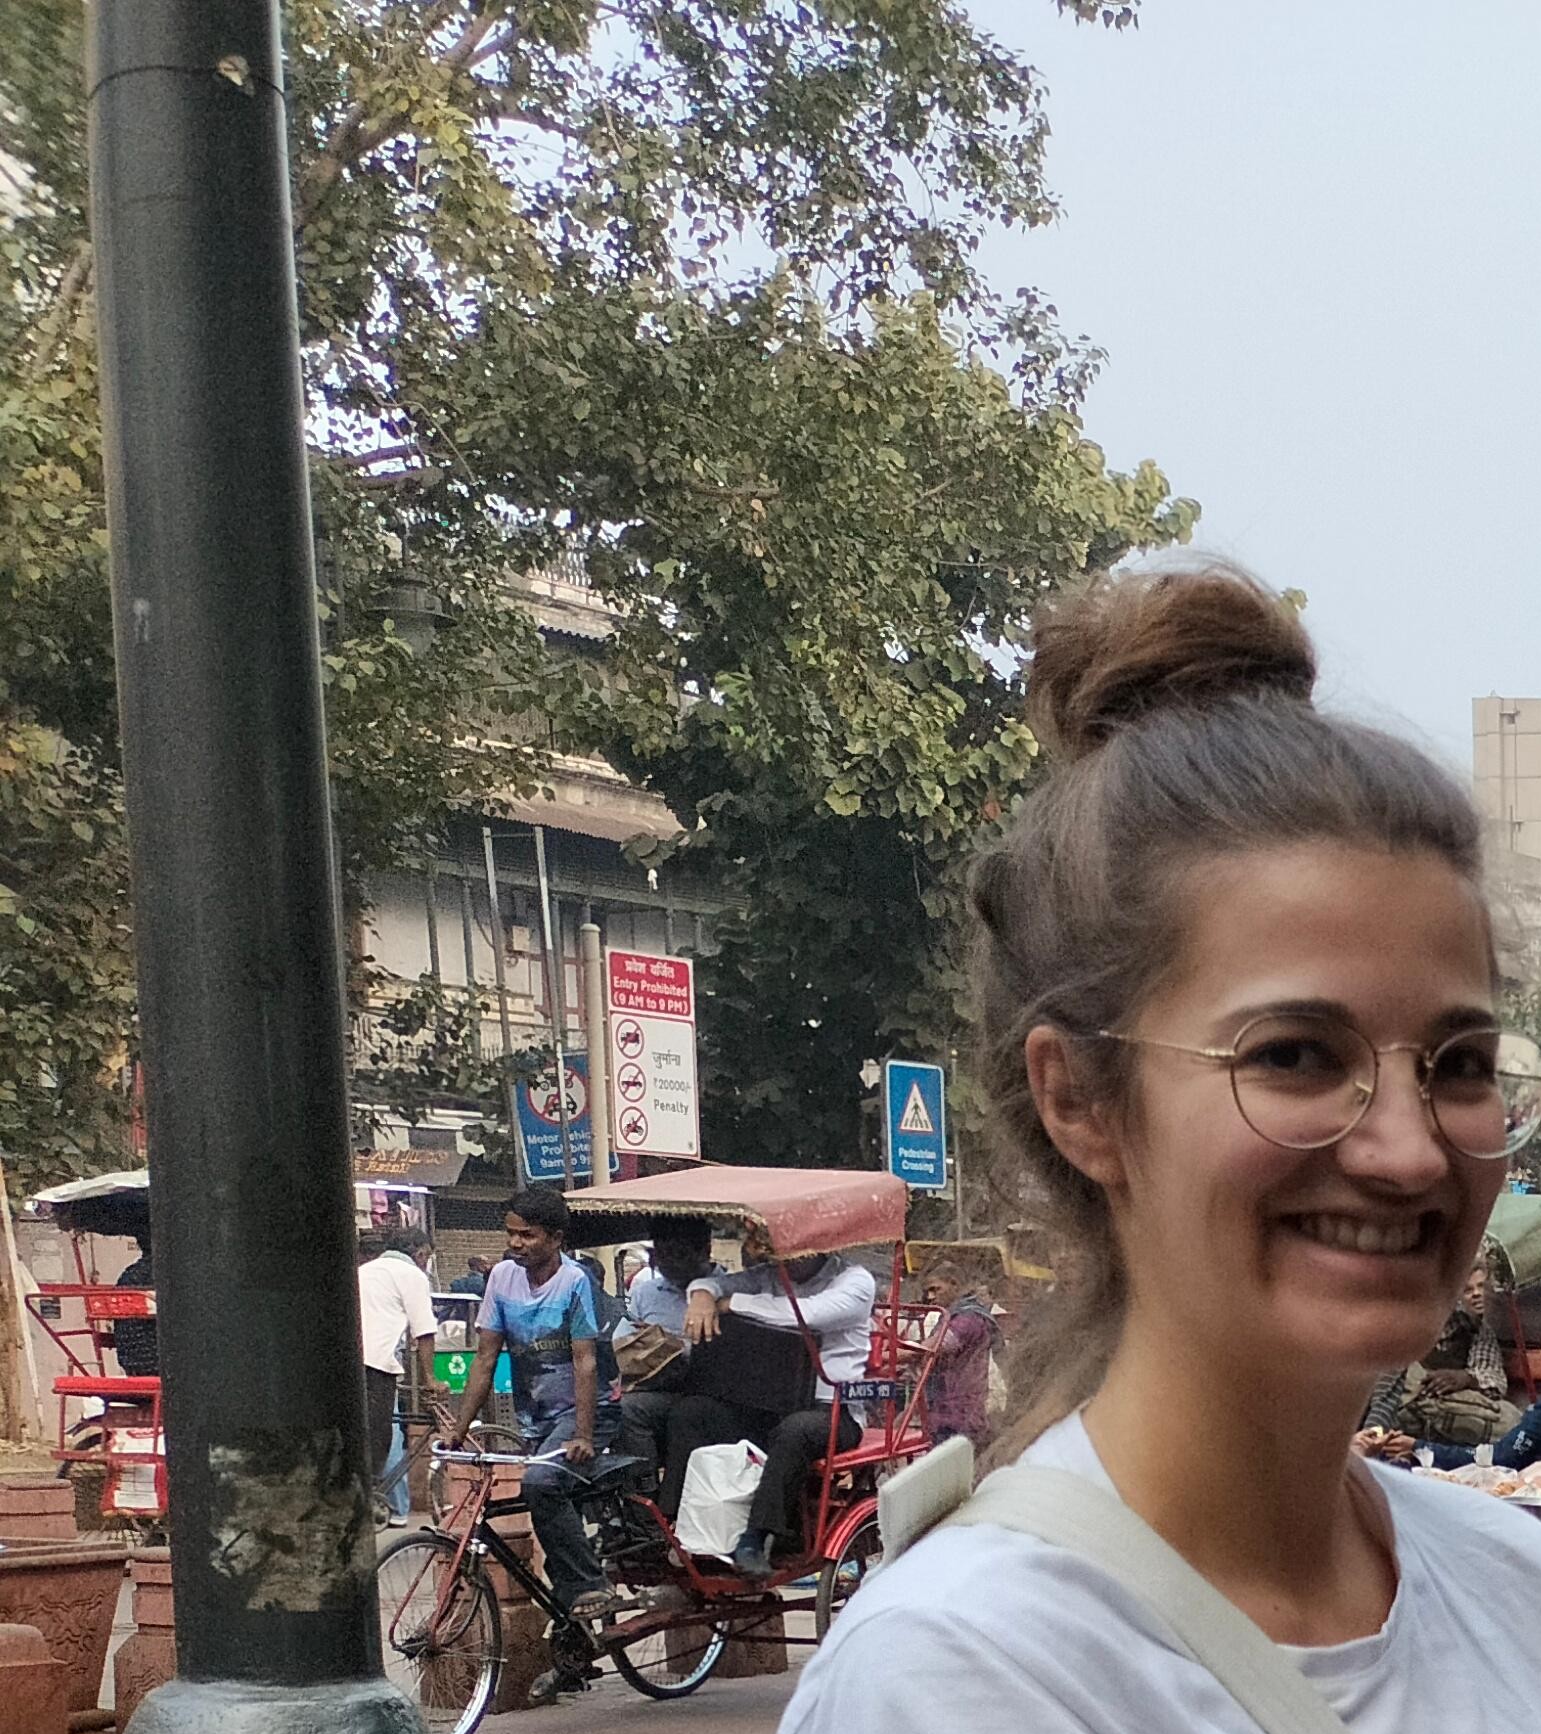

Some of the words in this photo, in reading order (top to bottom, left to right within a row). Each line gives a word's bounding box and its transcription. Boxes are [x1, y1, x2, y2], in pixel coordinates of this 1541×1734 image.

[613, 976, 638, 993] Entry
[641, 979, 688, 998] Prohibited
[628, 994, 645, 1008] AM
[646, 997, 657, 1010] to
[653, 1098, 689, 1115] Penalty
[526, 1133, 560, 1144] Motor
